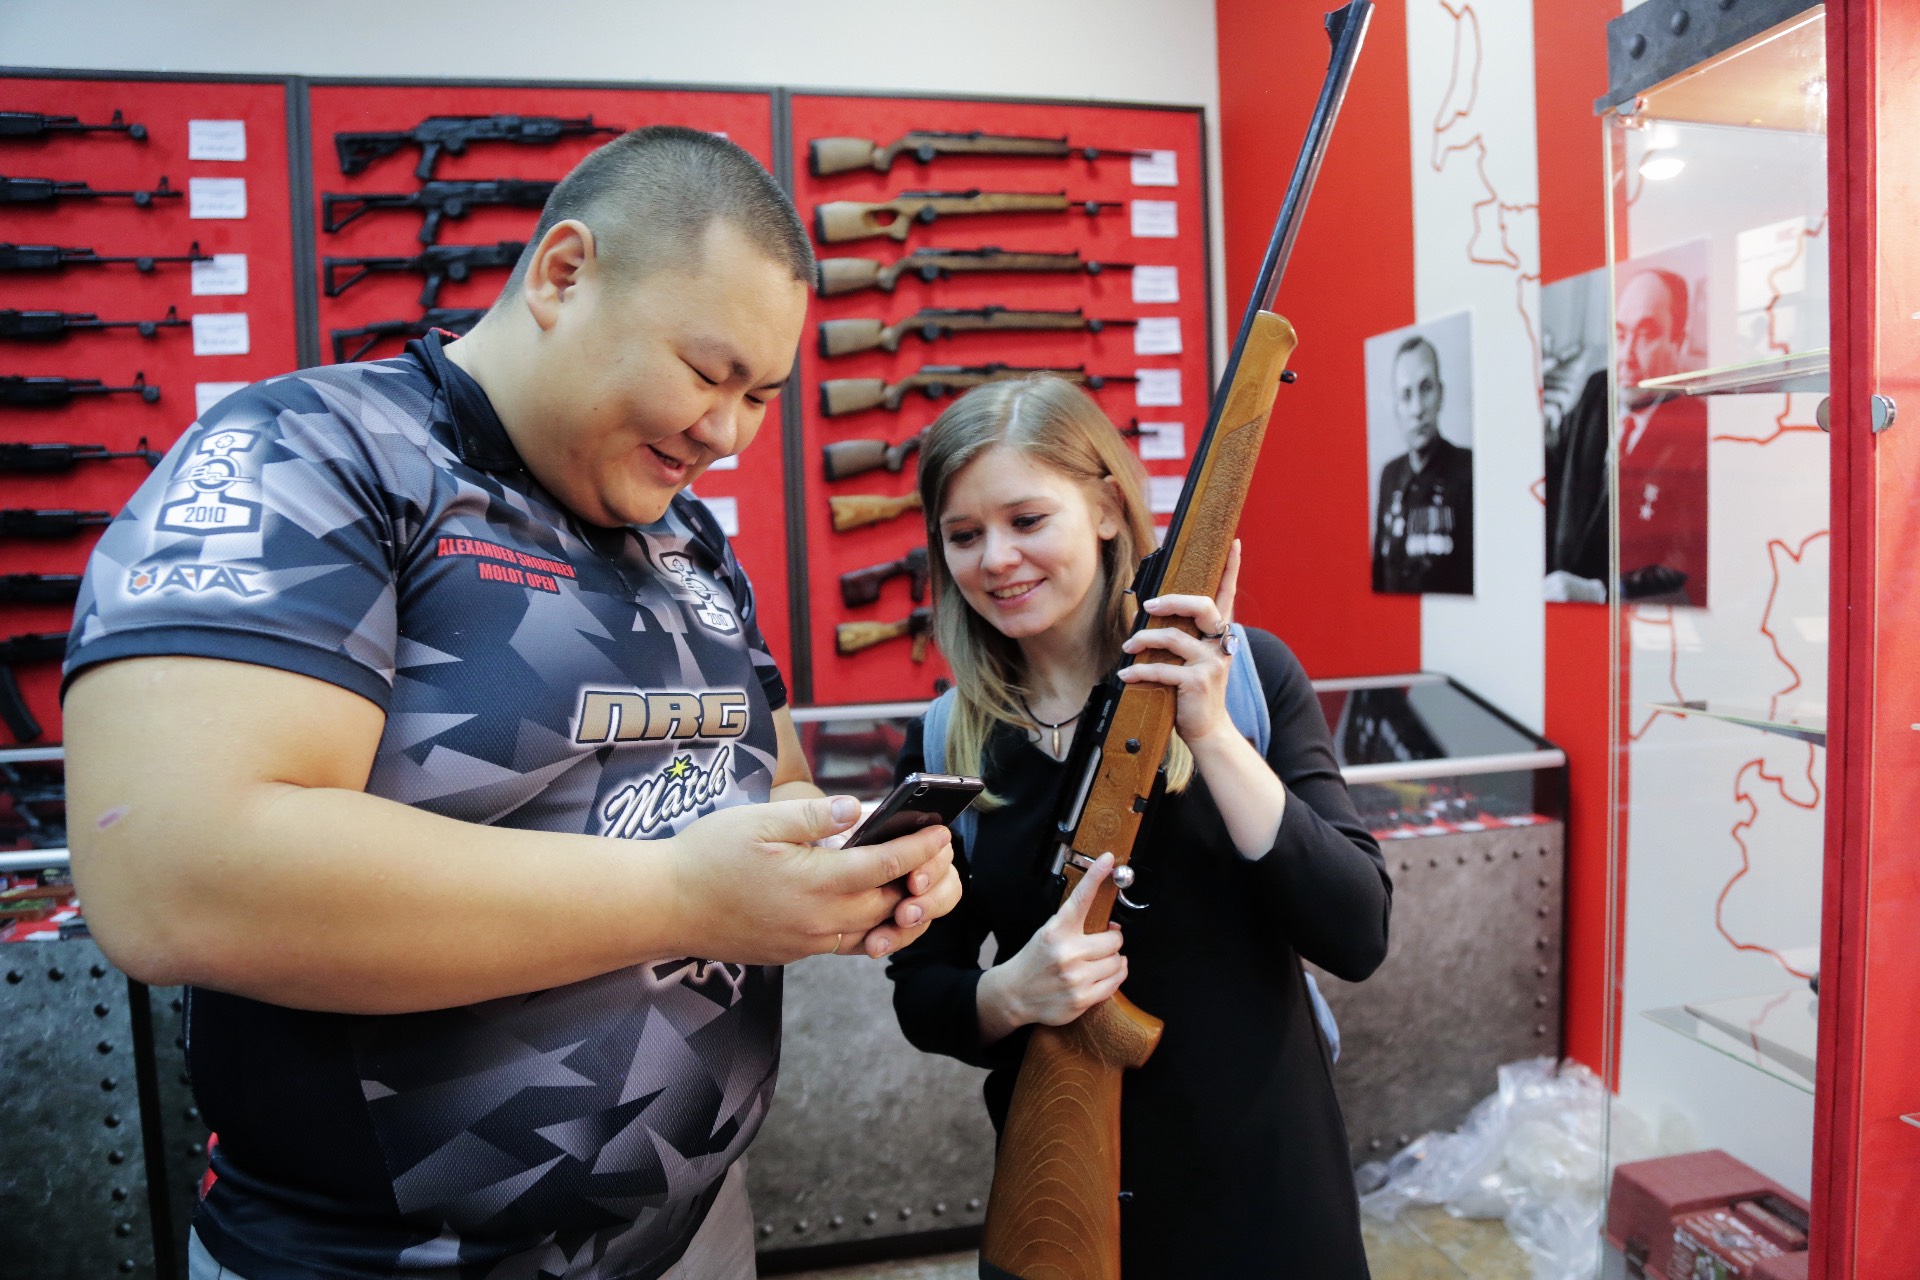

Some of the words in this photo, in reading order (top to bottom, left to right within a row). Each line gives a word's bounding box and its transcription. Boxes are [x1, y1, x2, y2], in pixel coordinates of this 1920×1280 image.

[183, 506, 227, 523] 2010
[438, 538, 517, 563] ALEXANDER
[479, 563, 524, 584] MOLOT
[526, 573, 558, 592] OPEN
[575, 690, 748, 743] NRG
[604, 745, 730, 839] Match
